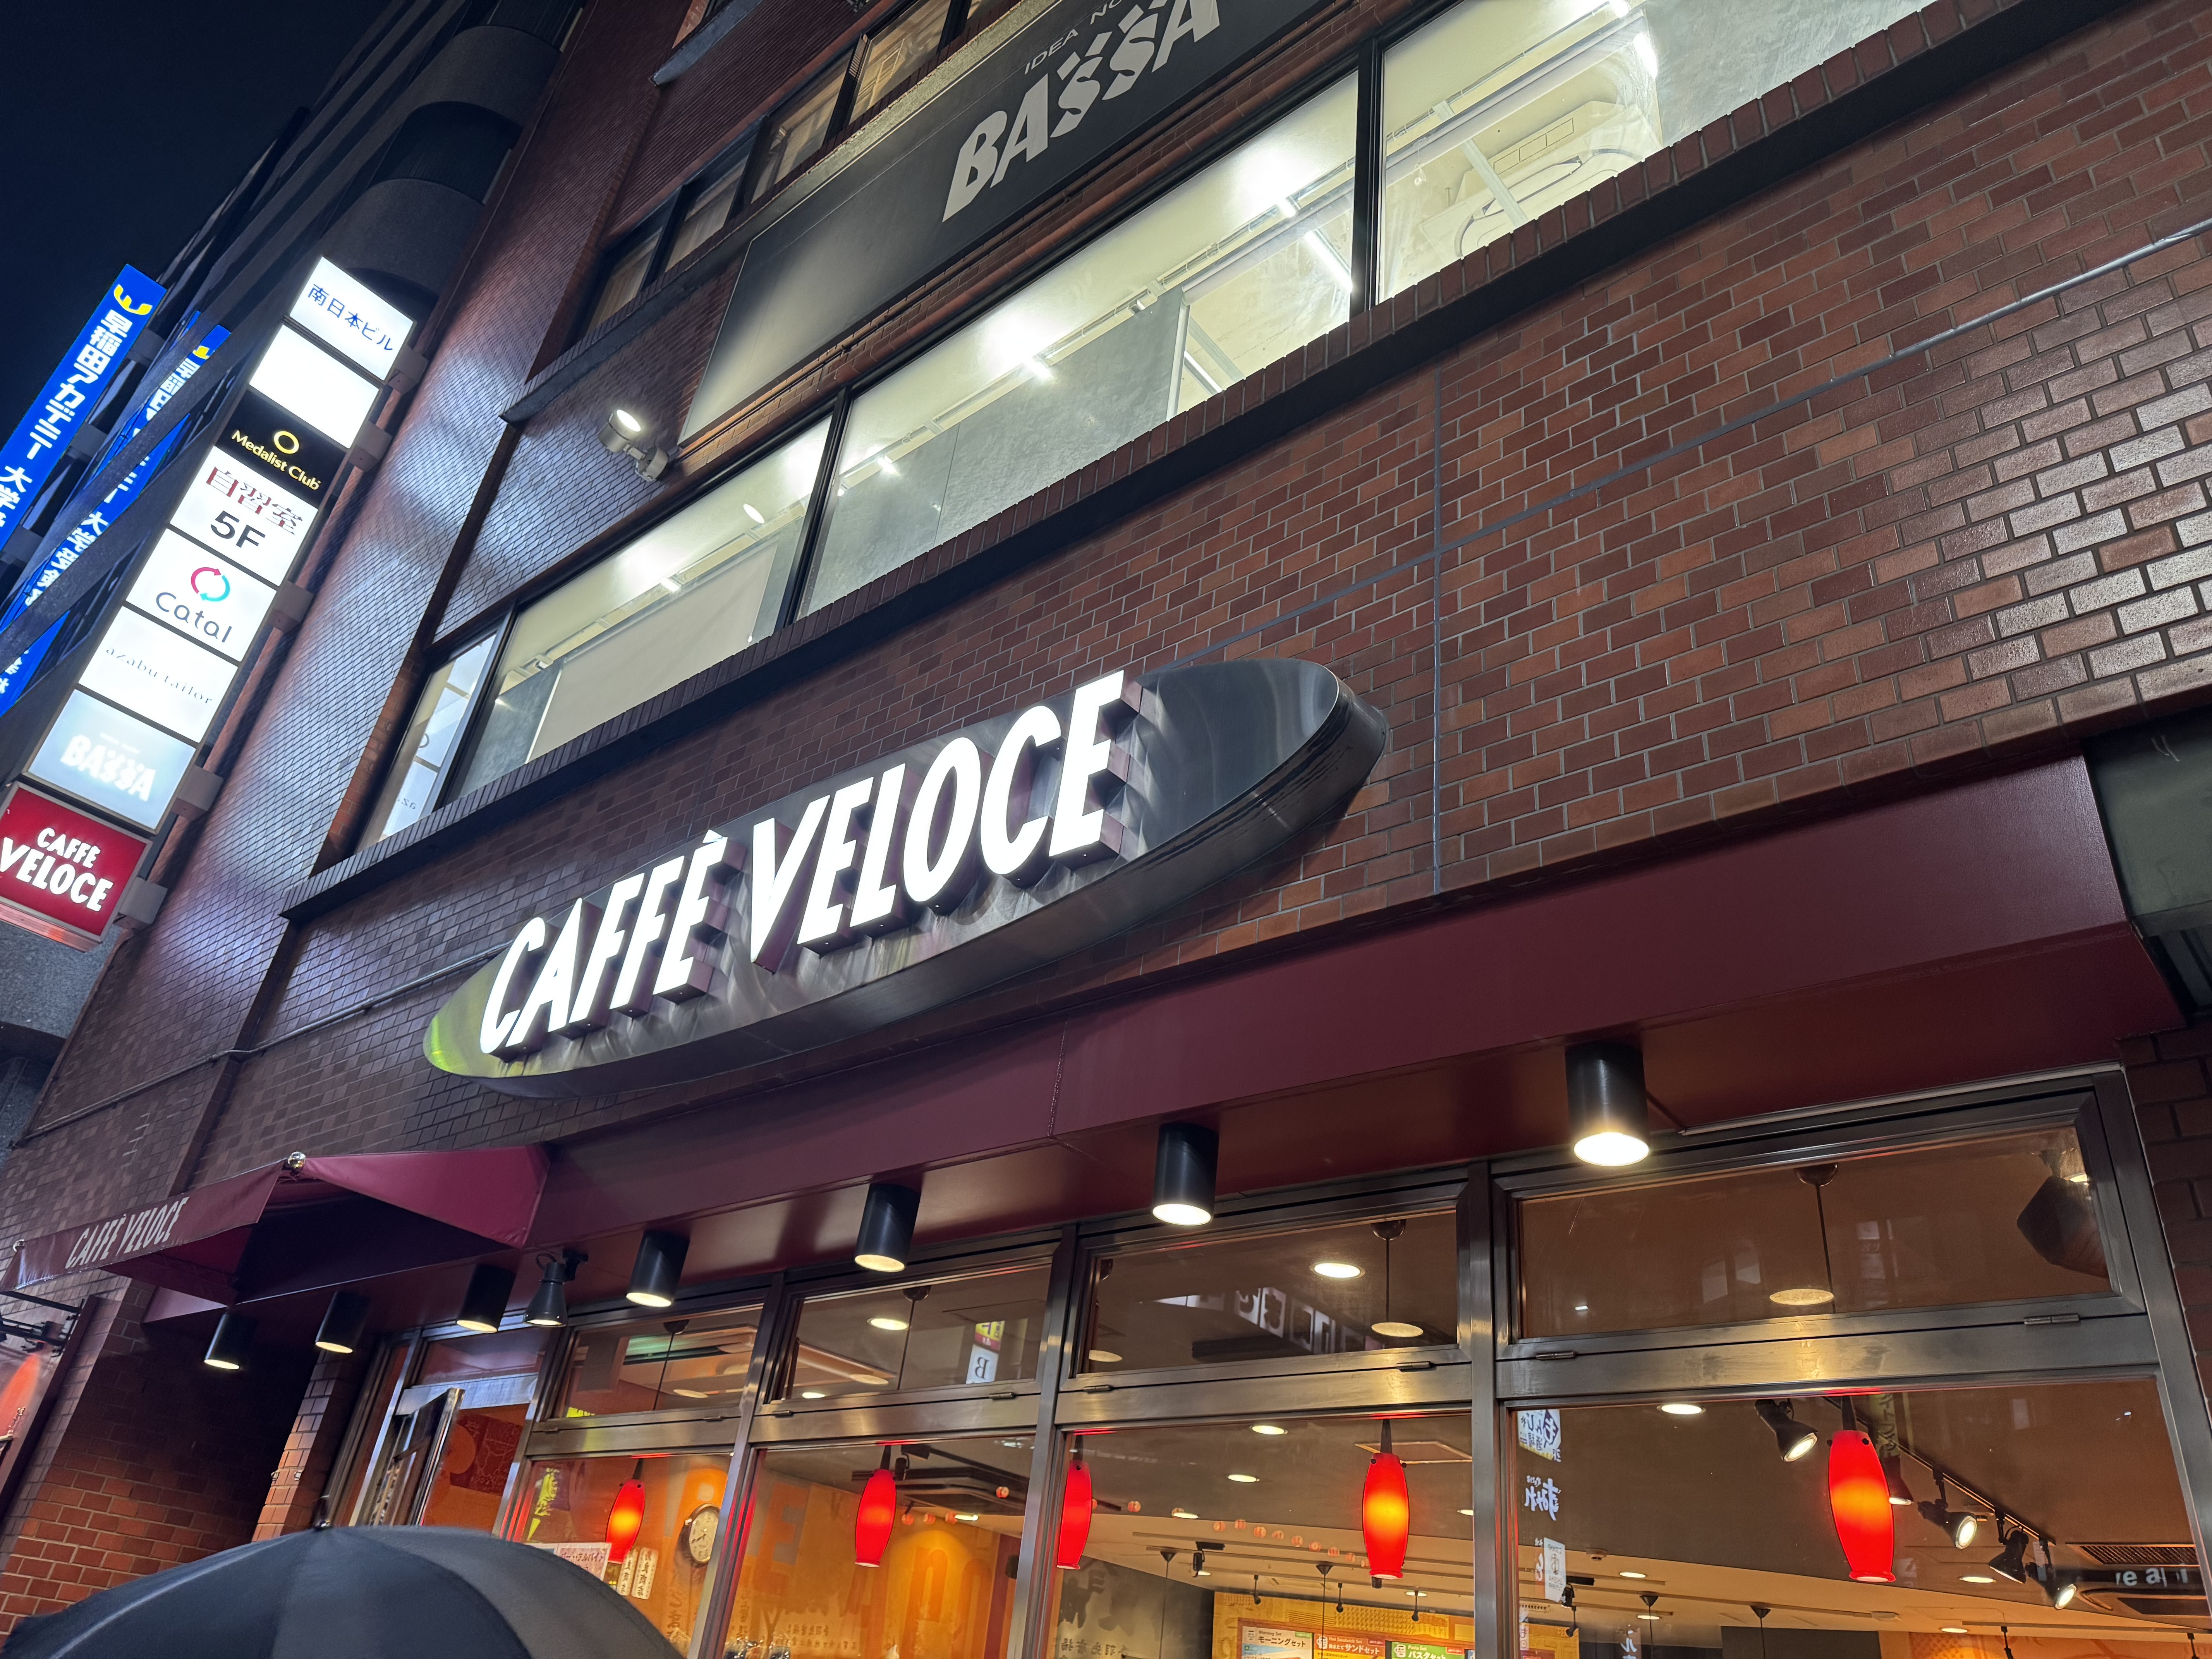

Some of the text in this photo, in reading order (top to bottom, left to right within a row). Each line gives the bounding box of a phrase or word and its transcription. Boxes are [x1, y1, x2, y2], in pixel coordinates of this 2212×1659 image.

[1024, 28, 1079, 74] IDEA
[942, 0, 1220, 222] BASSA
[307, 283, 393, 351] 南日本ビル
[0, 309, 132, 527] 早稲田アカデミー 大学
[231, 430, 321, 491] Medalist Club
[206, 466, 303, 536] 自習室
[211, 510, 266, 548] 5F
[106, 647, 212, 704] azabu tailor
[60, 734, 156, 802] BASSA
[0, 837, 113, 912] VELOCE
[479, 670, 1125, 1055] CAFFÈ VELOCE
[116, 1197, 189, 1256] VELOCE
[1258, 1636, 1306, 1648] モーニングセット
